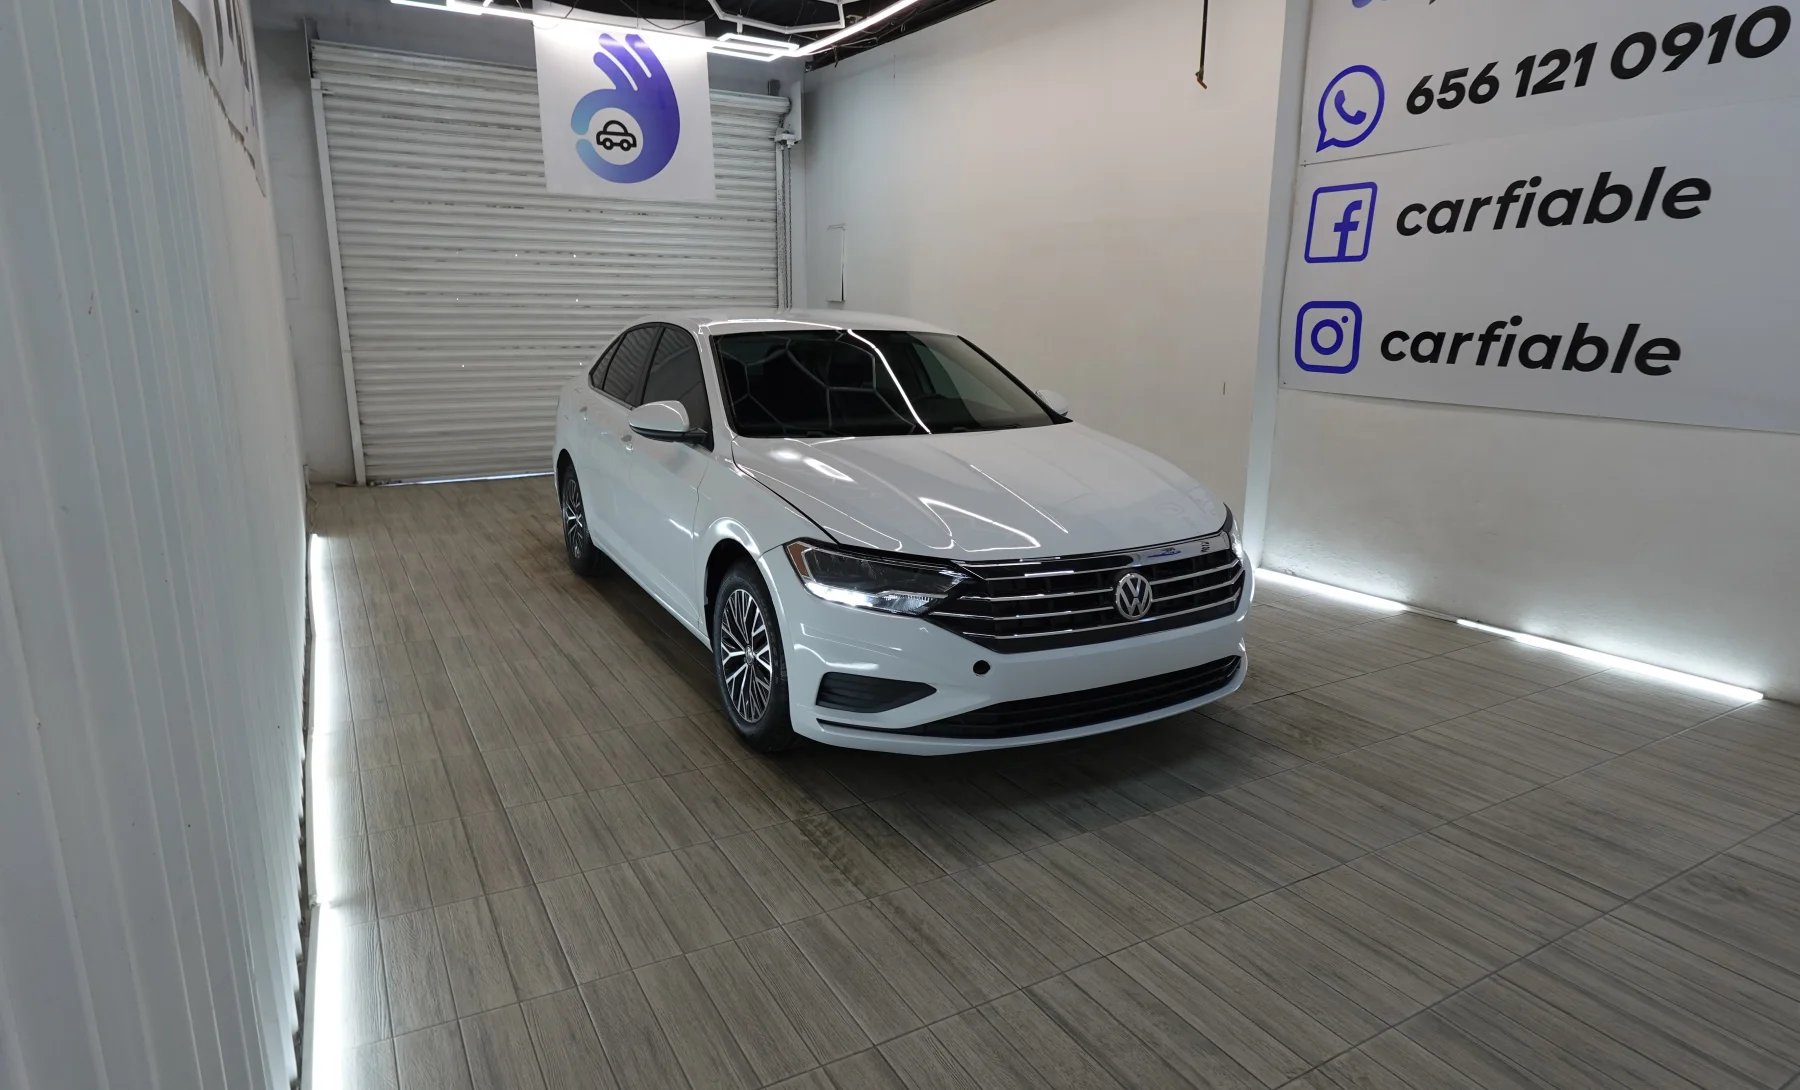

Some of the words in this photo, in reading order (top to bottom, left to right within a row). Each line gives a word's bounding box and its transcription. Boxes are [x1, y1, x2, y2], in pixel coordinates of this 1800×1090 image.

[1405, 61, 1500, 116] 656
[1514, 41, 1598, 99] 121
[1609, 4, 1792, 81] 0910
[1396, 165, 1712, 237] carfiable
[1380, 315, 1682, 377] carfiable
